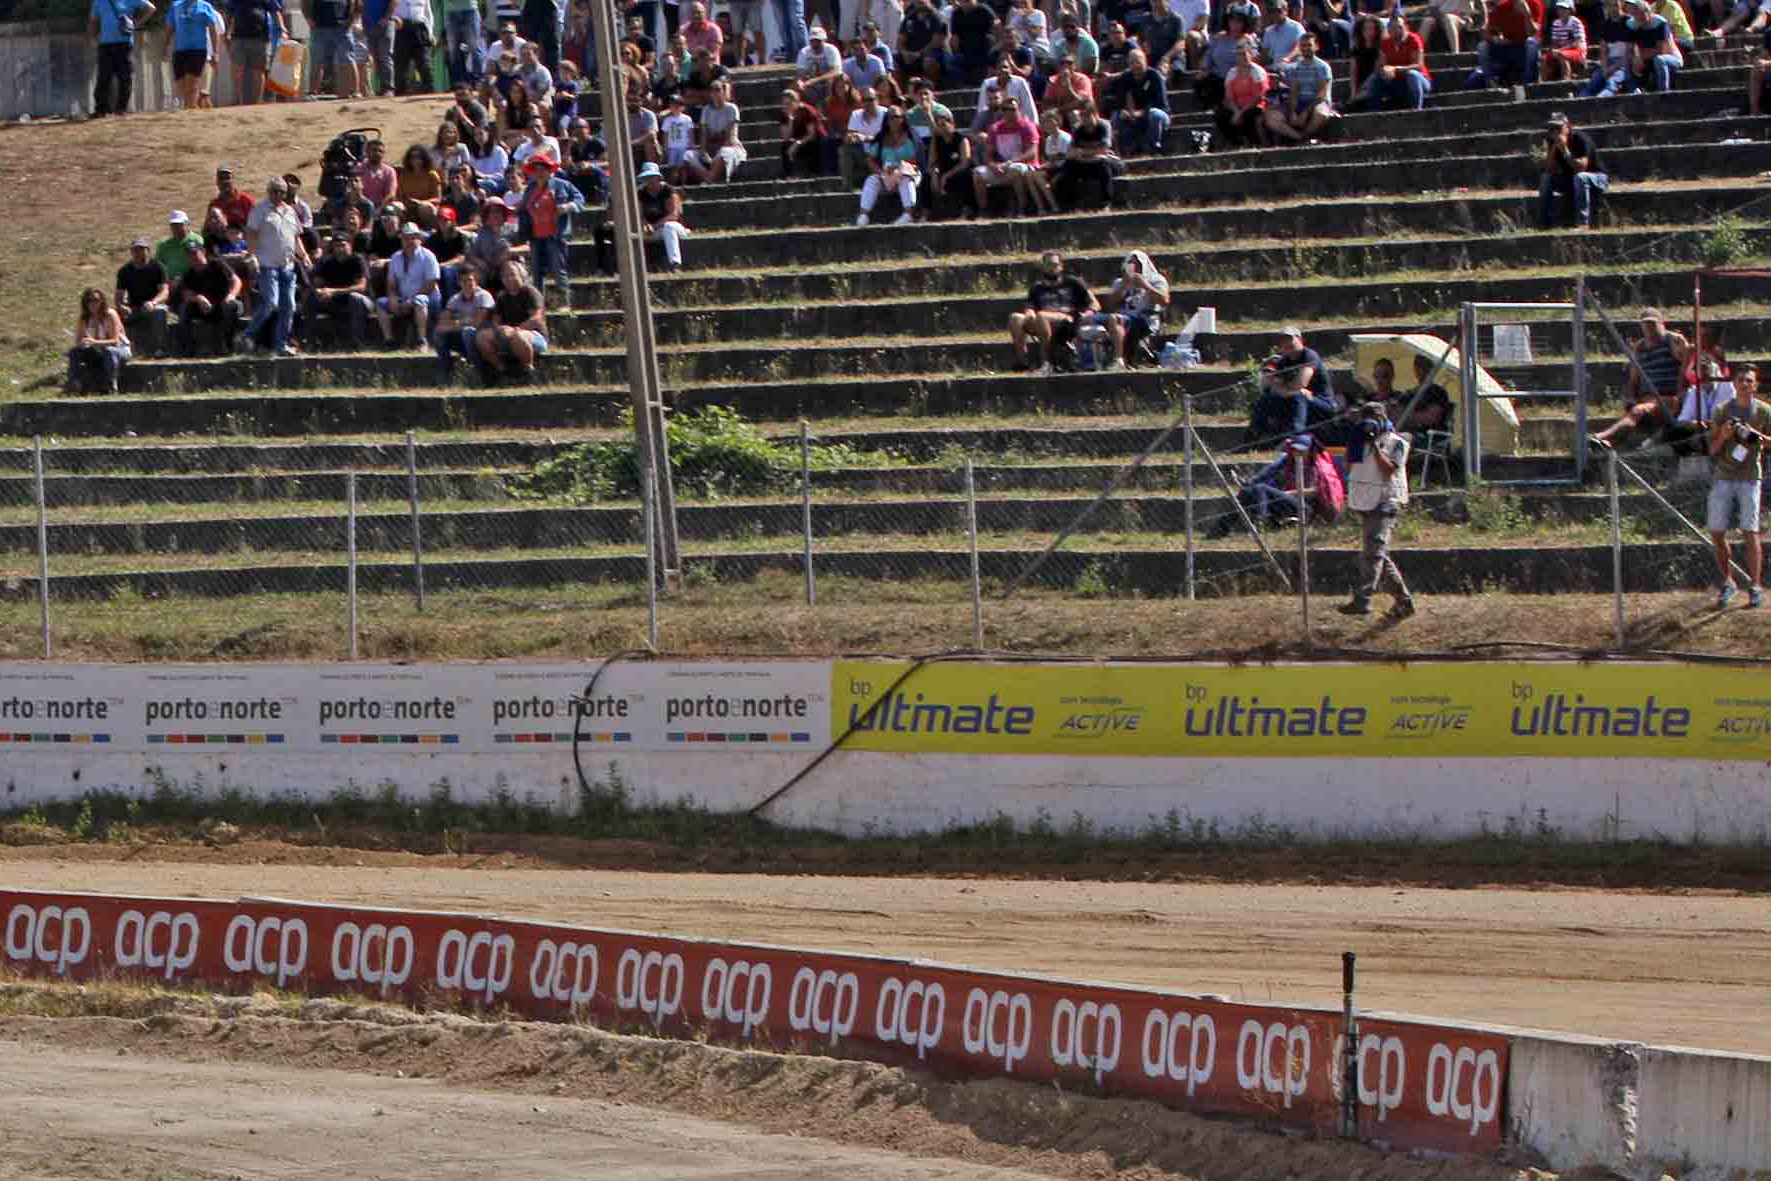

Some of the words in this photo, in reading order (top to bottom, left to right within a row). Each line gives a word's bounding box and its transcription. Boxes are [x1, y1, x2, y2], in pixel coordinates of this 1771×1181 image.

[849, 692, 1036, 735] ultimate
[850, 679, 871, 699] bp
[1061, 714, 1142, 731] ACTIVE
[1185, 696, 1367, 738] ultimate
[1186, 683, 1207, 701] bp
[1390, 714, 1469, 731] ACTIVE
[1510, 693, 1691, 737] ultimate
[1511, 680, 1533, 699] bp
[1716, 718, 1771, 735] ACTIV
[6, 905, 91, 975] acp
[115, 910, 200, 979] acp
[225, 914, 307, 987] acp
[332, 921, 414, 993] acp
[437, 929, 515, 1001] acp
[530, 939, 598, 1015] acp
[617, 948, 684, 1022] acp
[703, 958, 771, 1035] acp
[789, 966, 858, 1042] acp
[877, 977, 945, 1057] acp
[964, 988, 1031, 1070] acp
[1052, 998, 1120, 1087] acp
[1142, 1008, 1216, 1095] acp
[1236, 1019, 1310, 1107] acp
[1427, 1043, 1499, 1136] acp
